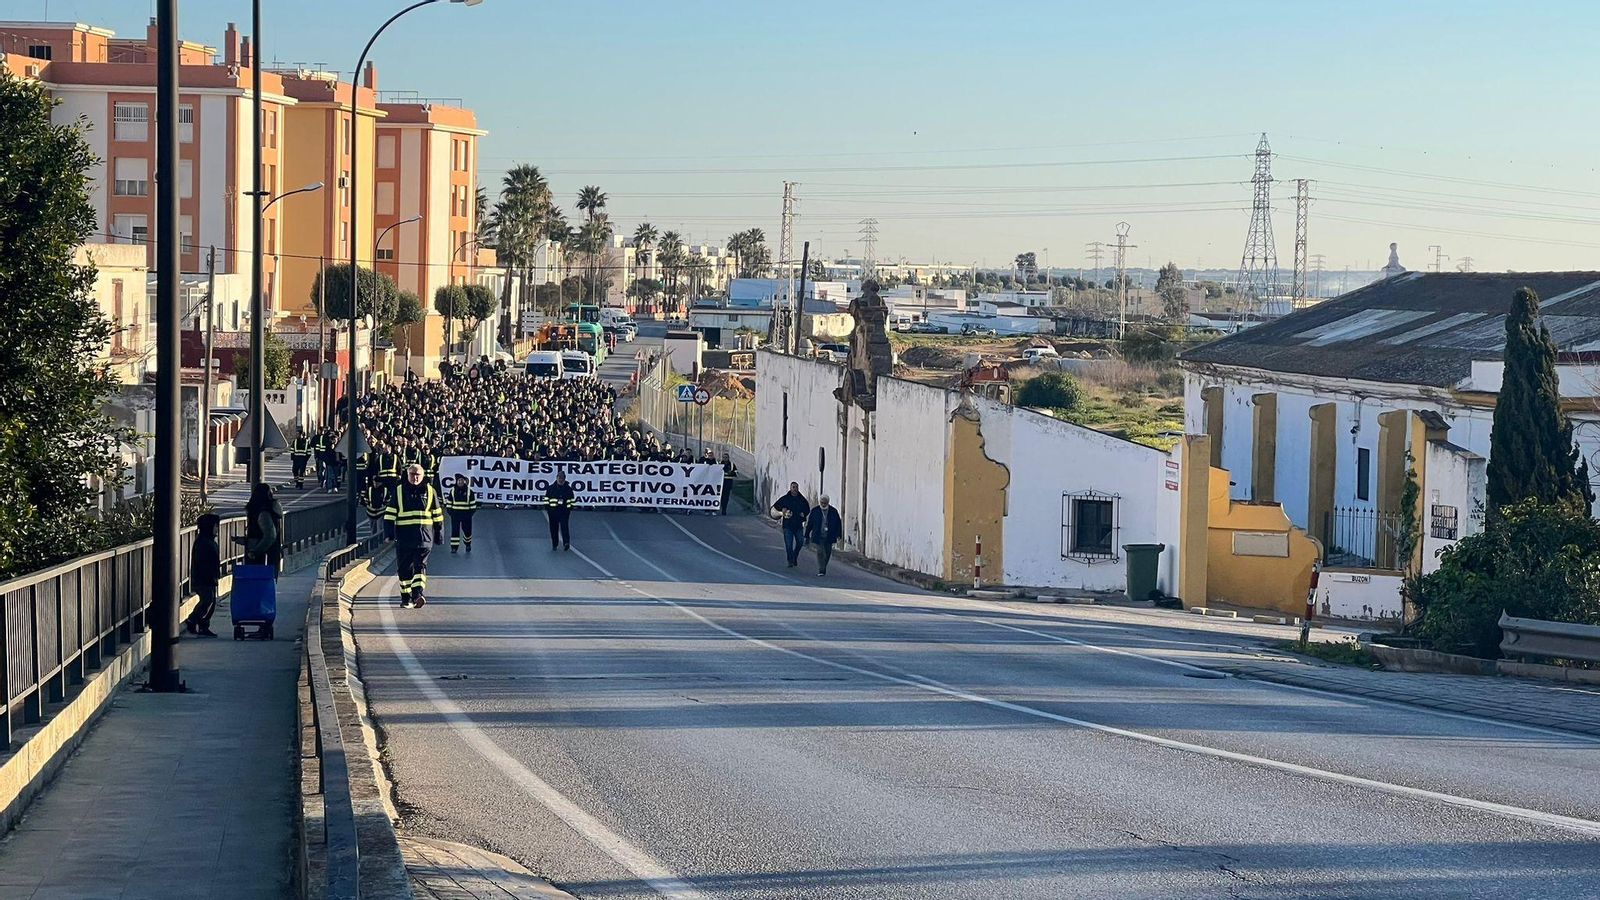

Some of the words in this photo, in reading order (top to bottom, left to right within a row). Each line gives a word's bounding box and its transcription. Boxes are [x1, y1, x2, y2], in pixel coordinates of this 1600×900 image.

[466, 459, 520, 473] PLAN
[528, 462, 674, 477] ESTRATEGICO
[681, 466, 695, 477] Y
[441, 476, 549, 491] CNVENIO
[569, 480, 676, 494] OLECTIVO
[682, 483, 721, 498] ¡YA!
[487, 492, 502, 500] DE
[506, 494, 546, 502] EMPRE
[629, 496, 652, 504] SAN
[656, 497, 720, 507] FERNANDO
